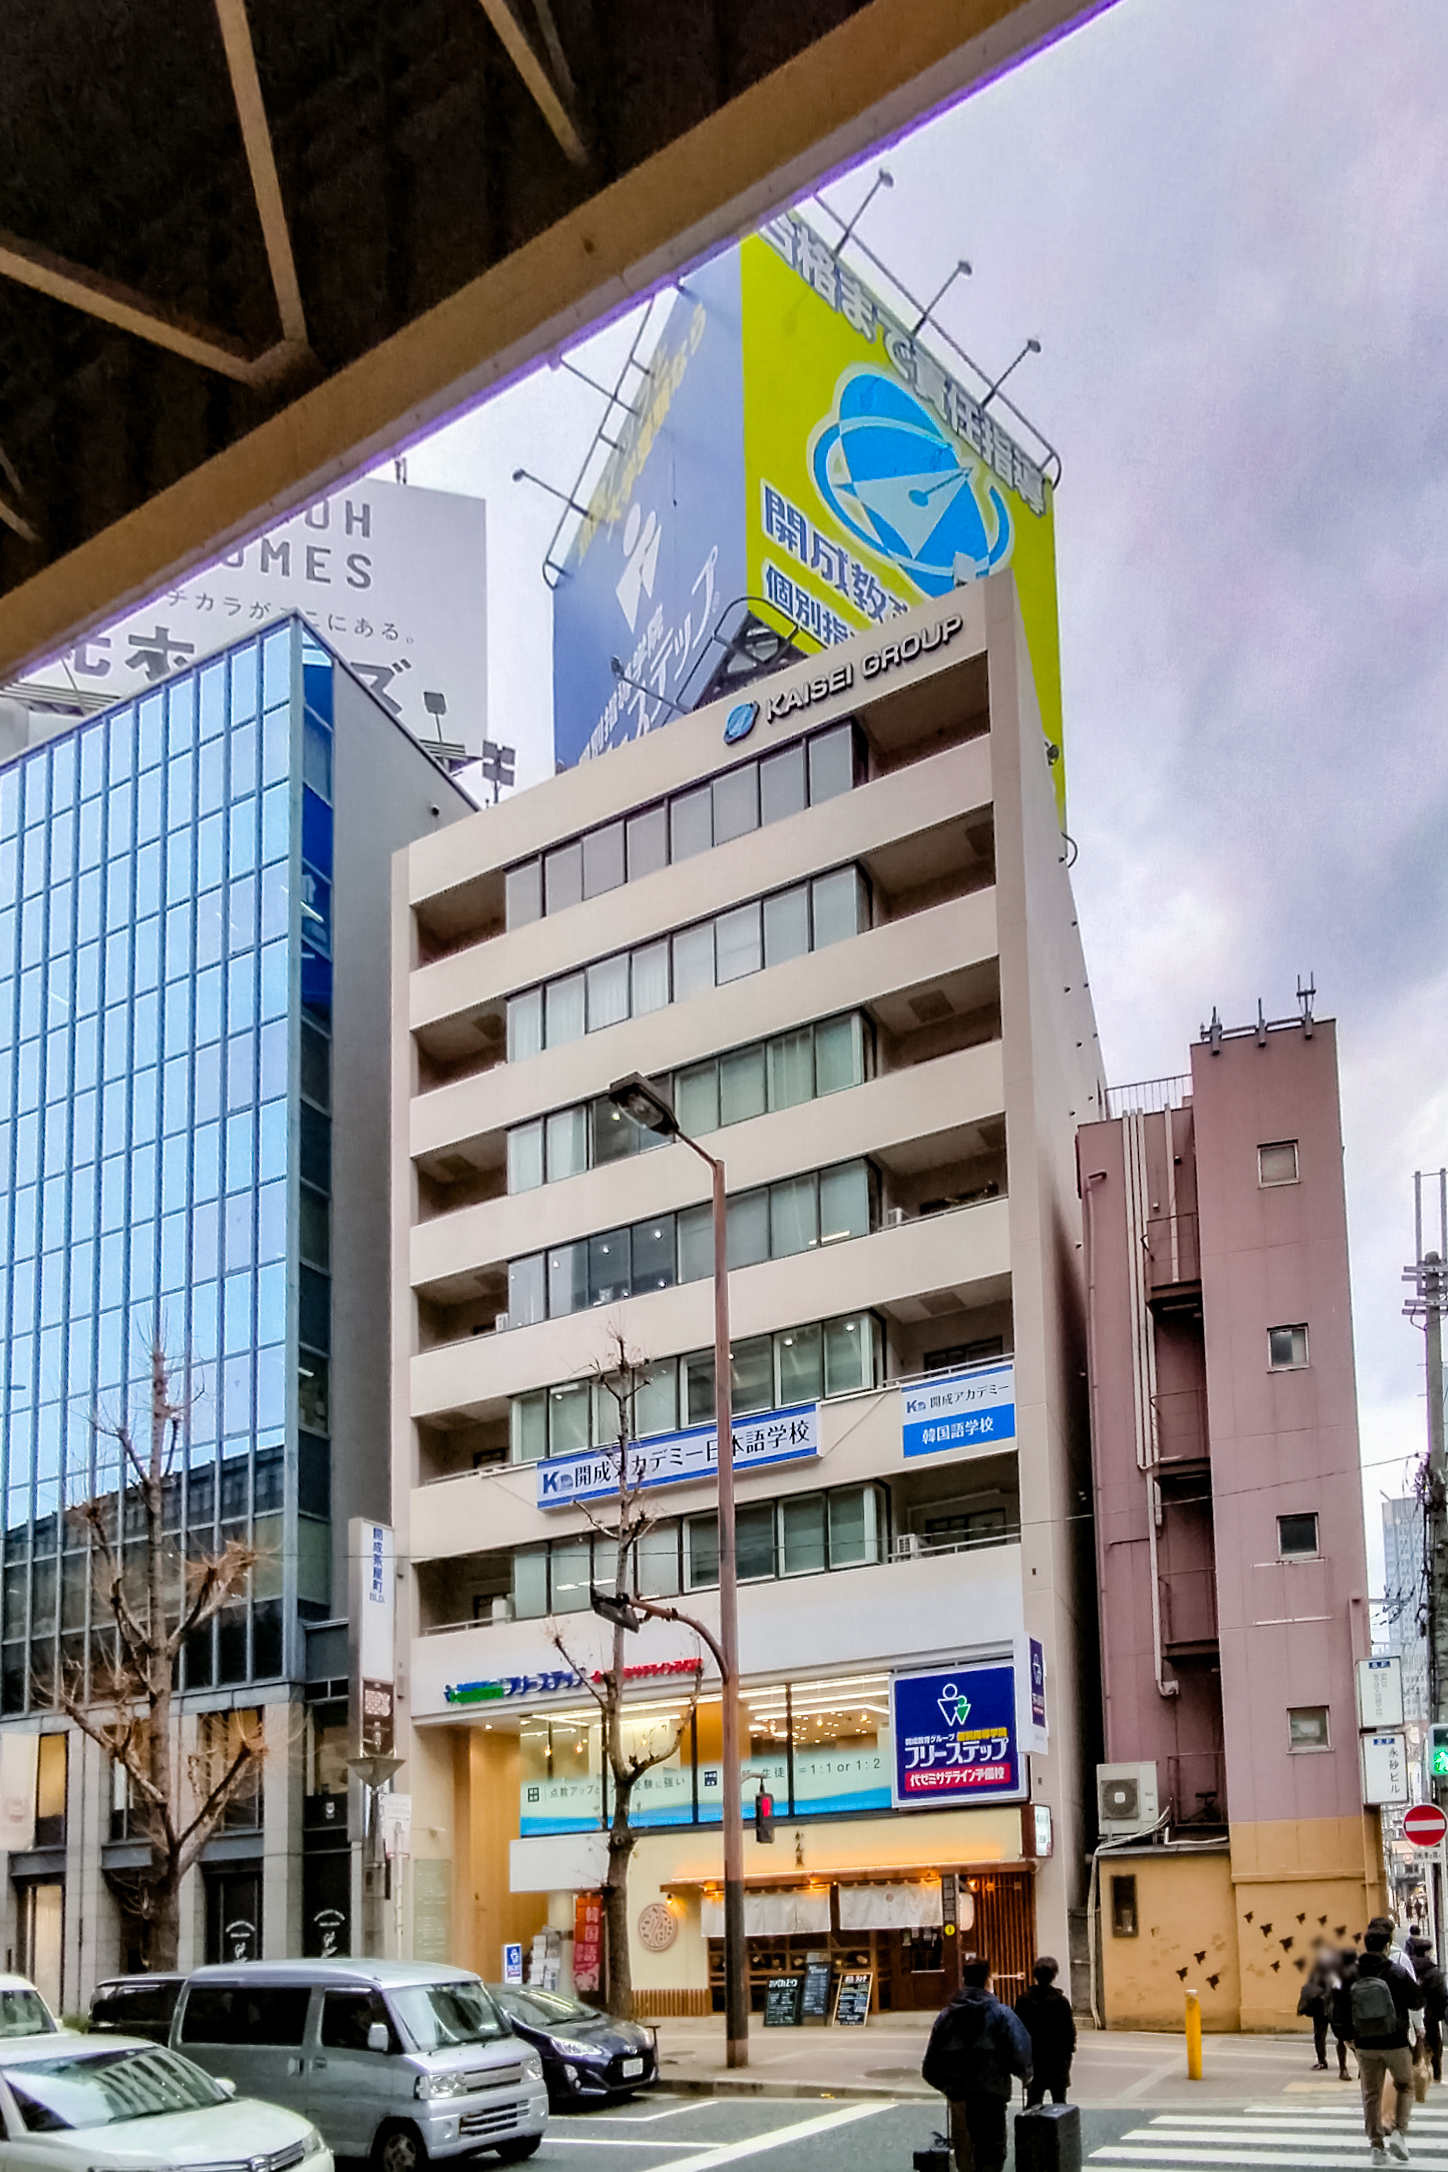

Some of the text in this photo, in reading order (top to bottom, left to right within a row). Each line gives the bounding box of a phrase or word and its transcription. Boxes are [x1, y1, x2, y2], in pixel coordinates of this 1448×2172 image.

[167, 590, 414, 645] チカラがこにある。
[766, 564, 856, 645] 個別指
[767, 613, 963, 723] KAISEI GROUP
[930, 1384, 1009, 1409] 開成アカデミー
[921, 1416, 993, 1444] 韓国語学校
[837, 1763, 851, 1773] or
[905, 1737, 1009, 1769] フリーステップ
[795, 1830, 804, 1867] かん
